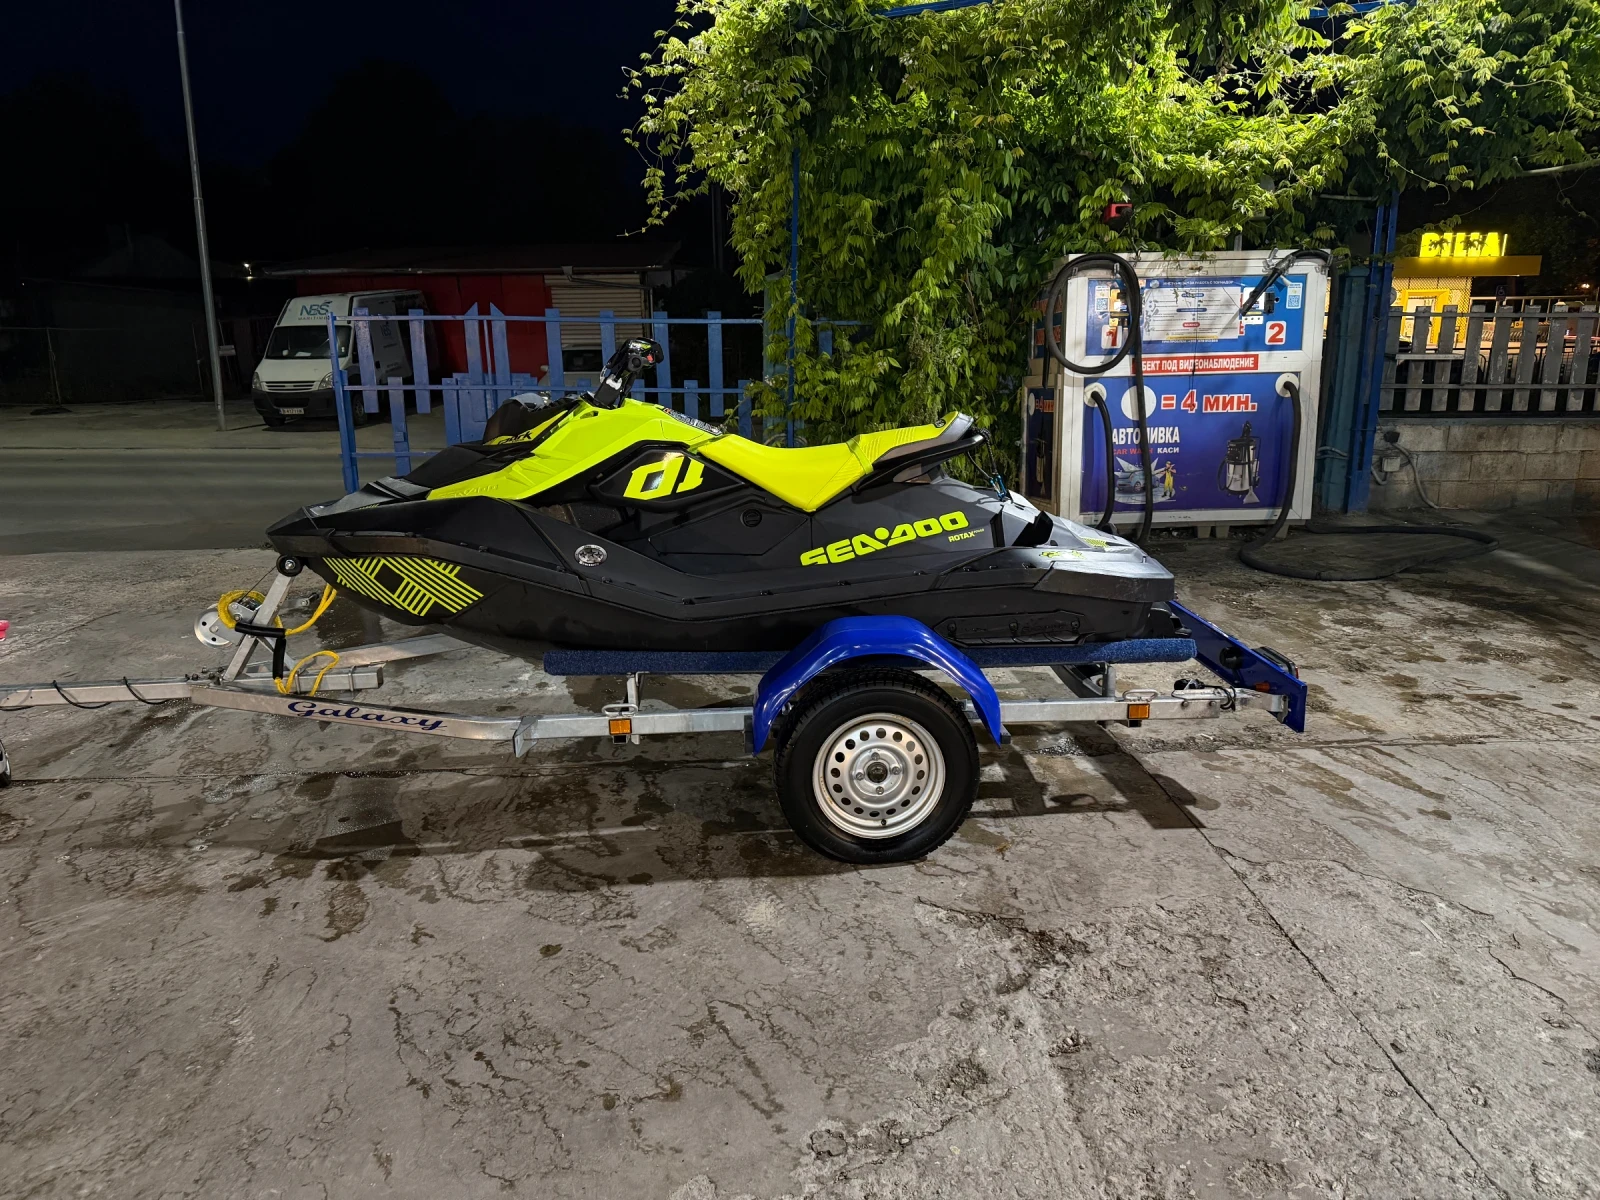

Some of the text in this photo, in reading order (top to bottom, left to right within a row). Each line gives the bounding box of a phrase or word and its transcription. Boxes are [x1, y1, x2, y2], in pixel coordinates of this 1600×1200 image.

[300, 304, 329, 316] NBS
[1267, 322, 1284, 343] 2
[1141, 357, 1255, 372] БЕКТ ПОД ВИДЕОНАБЛЮДЕНИЕ
[1181, 389, 1198, 413] 4
[1112, 426, 1180, 445] АВТОИВКА
[948, 531, 975, 543] ROTAX
[287, 700, 448, 731] Galaxy
